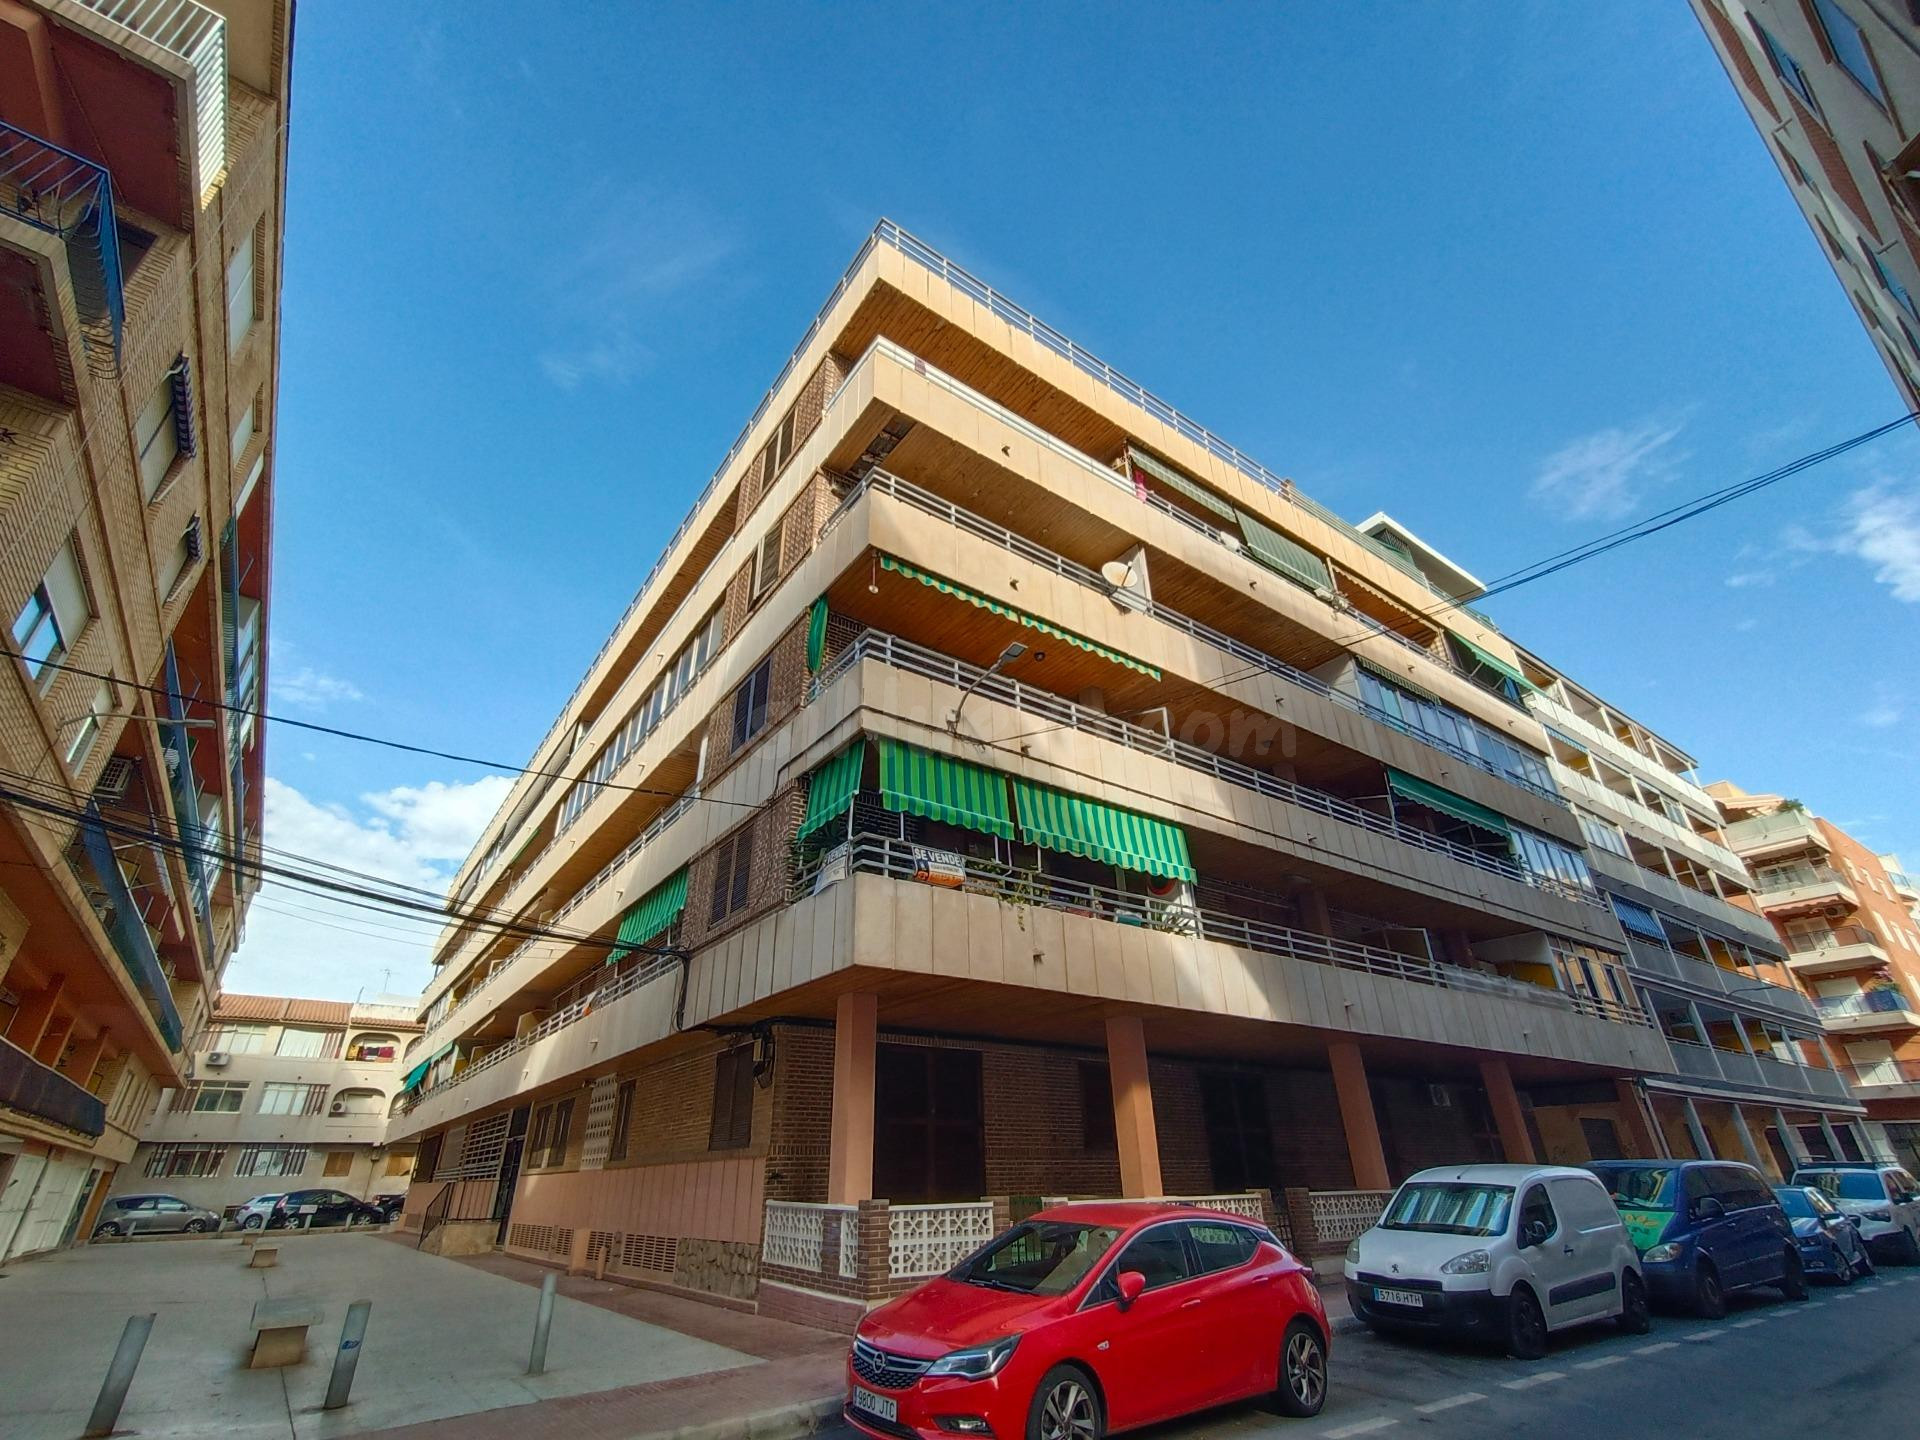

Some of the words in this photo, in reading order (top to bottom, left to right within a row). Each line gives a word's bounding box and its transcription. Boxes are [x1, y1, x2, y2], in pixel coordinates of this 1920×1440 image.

[914, 847, 928, 861] SE
[928, 850, 961, 867] VENDE
[1379, 1290, 1402, 1302] 5716
[1403, 1293, 1421, 1305] HTH
[858, 1391, 876, 1411] 9800
[879, 1399, 895, 1418] JTC
